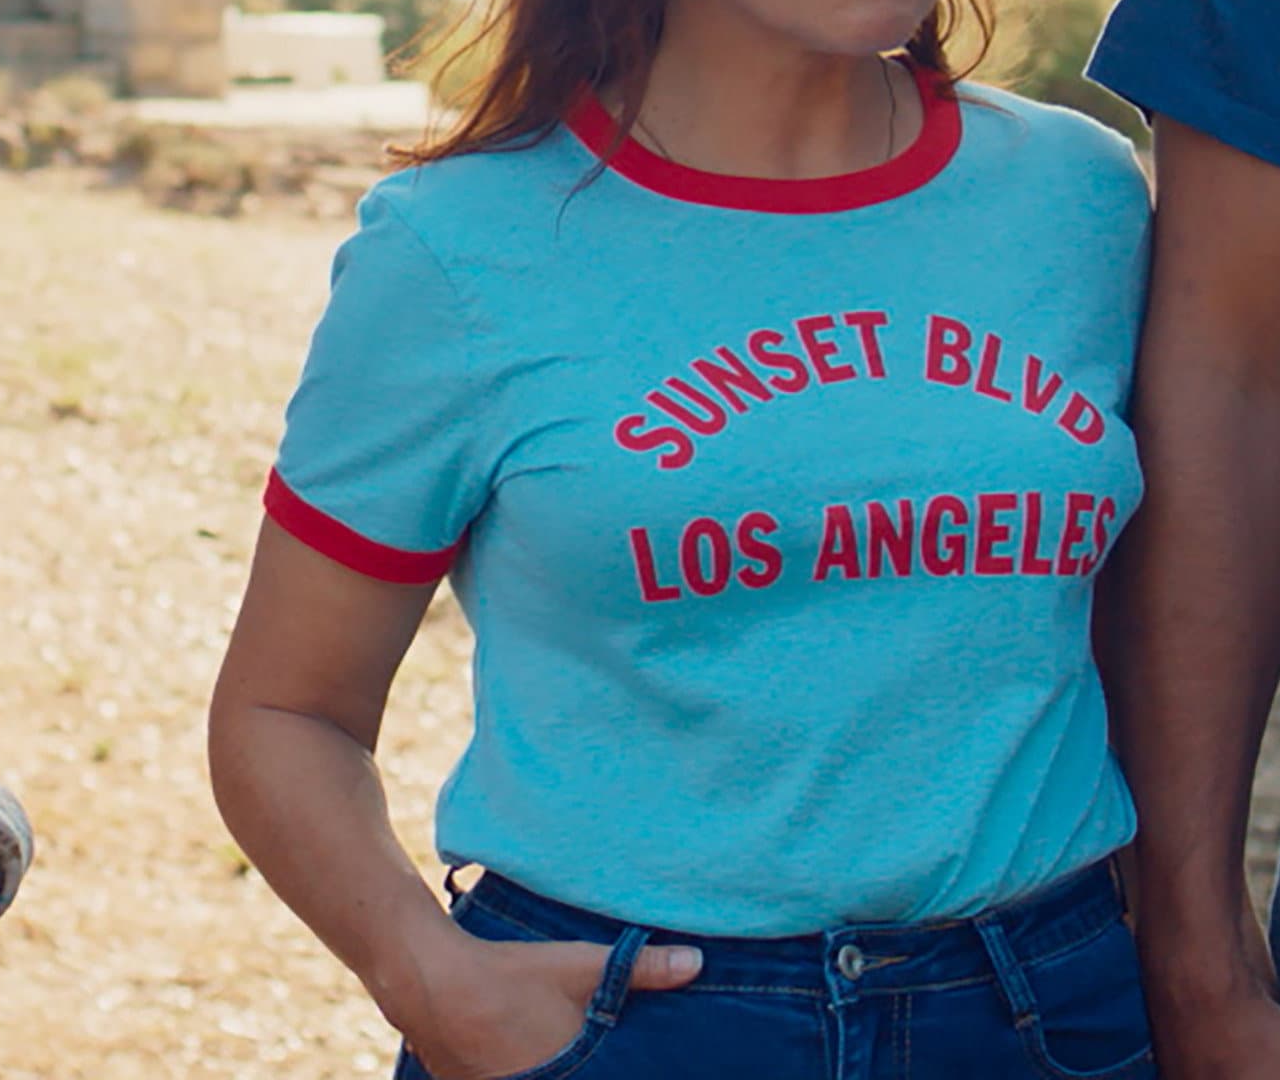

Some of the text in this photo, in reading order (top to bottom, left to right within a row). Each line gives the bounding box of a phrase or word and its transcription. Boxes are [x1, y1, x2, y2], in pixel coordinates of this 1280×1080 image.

[614, 311, 1107, 470] SUNSET BLVD
[628, 491, 1117, 604] LOS ANGELES
